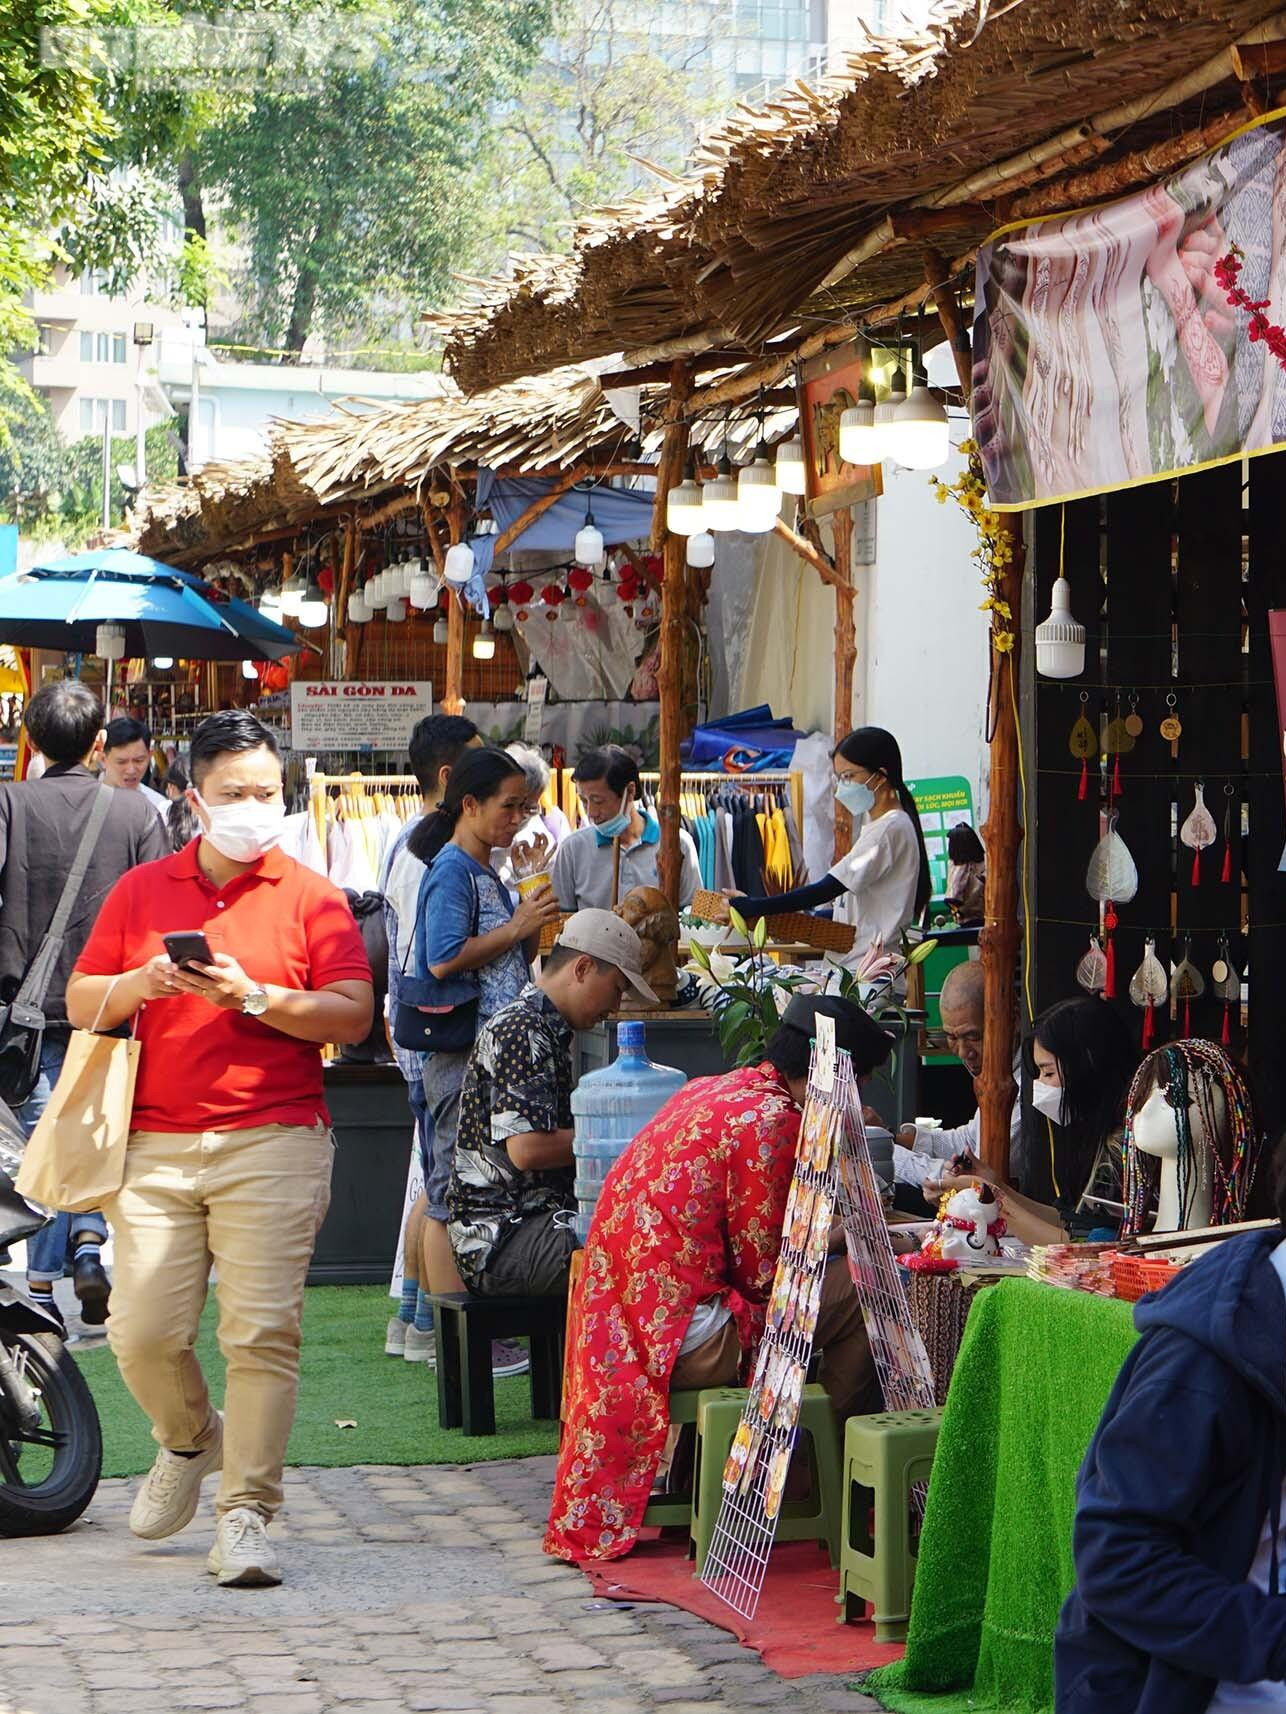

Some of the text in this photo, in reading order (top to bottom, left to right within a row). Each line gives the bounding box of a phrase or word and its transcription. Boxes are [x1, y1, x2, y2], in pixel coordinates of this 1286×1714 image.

[306, 682, 417, 696] SÀI GÒN DA
